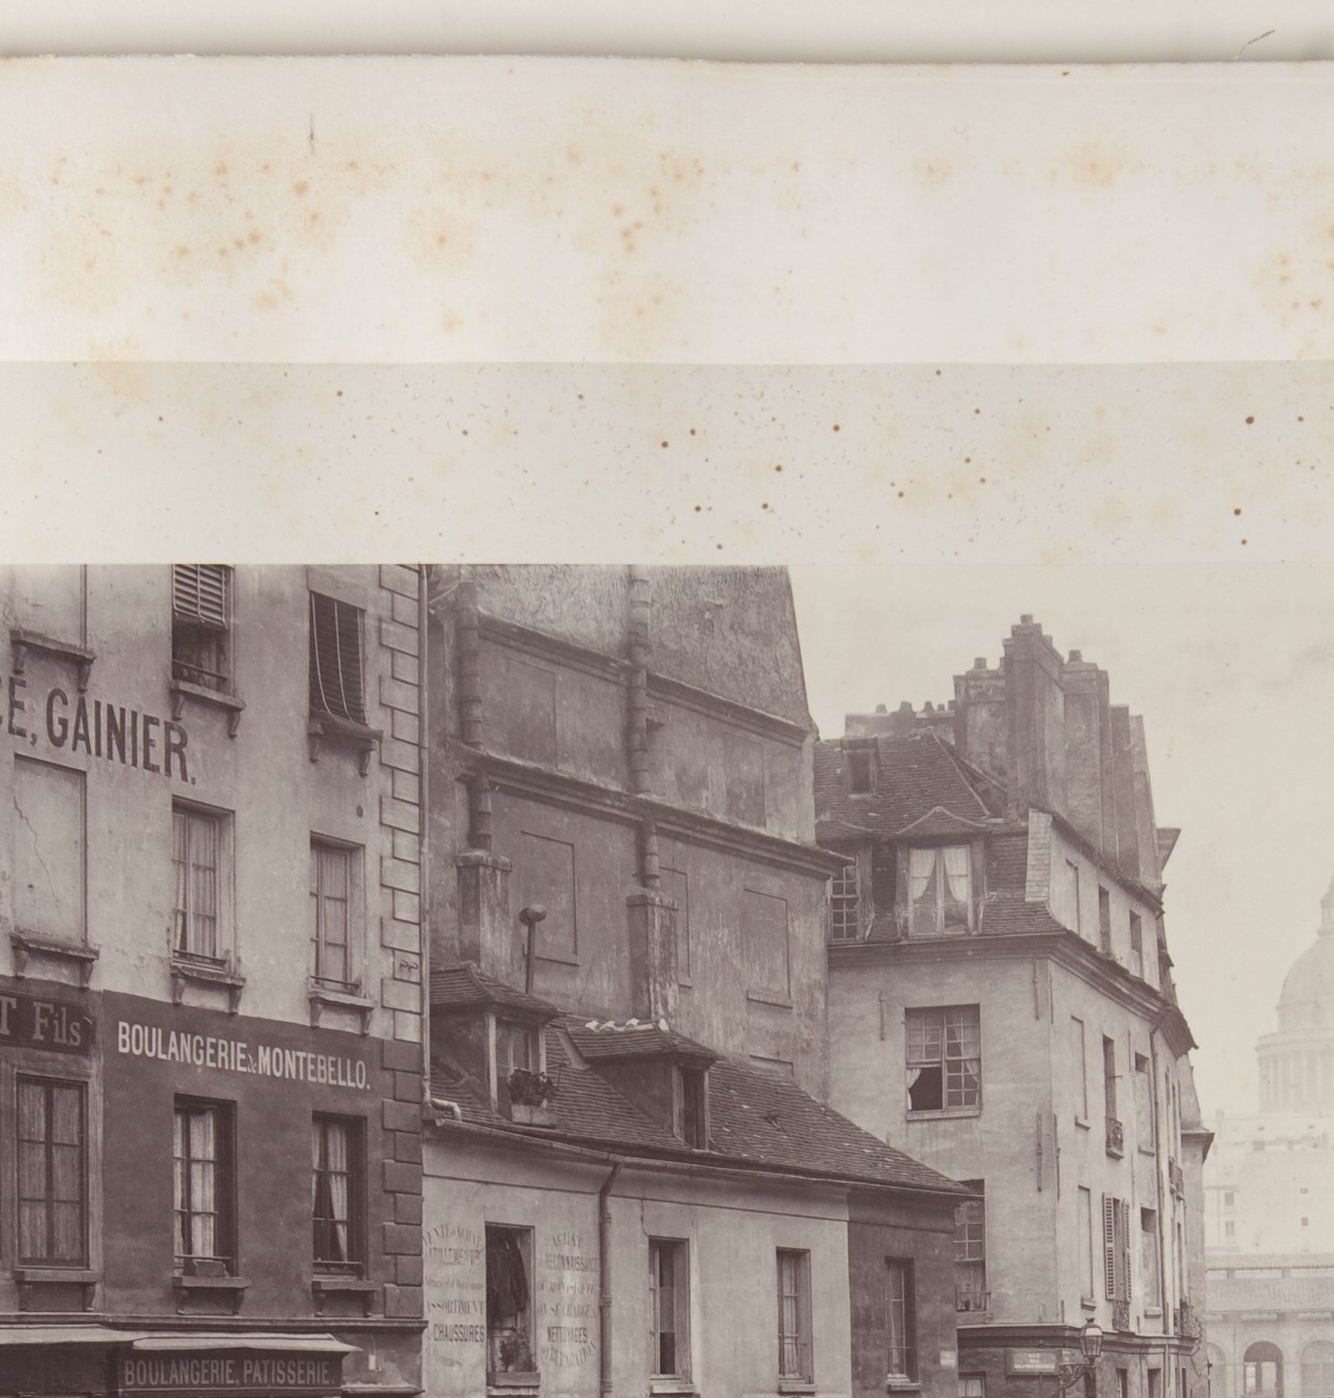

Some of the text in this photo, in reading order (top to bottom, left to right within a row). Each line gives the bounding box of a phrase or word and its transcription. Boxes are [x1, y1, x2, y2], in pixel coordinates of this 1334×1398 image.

[45, 687, 197, 786] GAINIER.
[32, 1001, 83, 1047] Fils
[118, 1020, 247, 1073] BOULANGERIE
[258, 1044, 371, 1091] MONTEBELLO.
[433, 1323, 486, 1344] CHAUSSURES
[123, 1359, 240, 1386] BOULANGERIE,
[243, 1359, 336, 1385] PATISSERIE.
